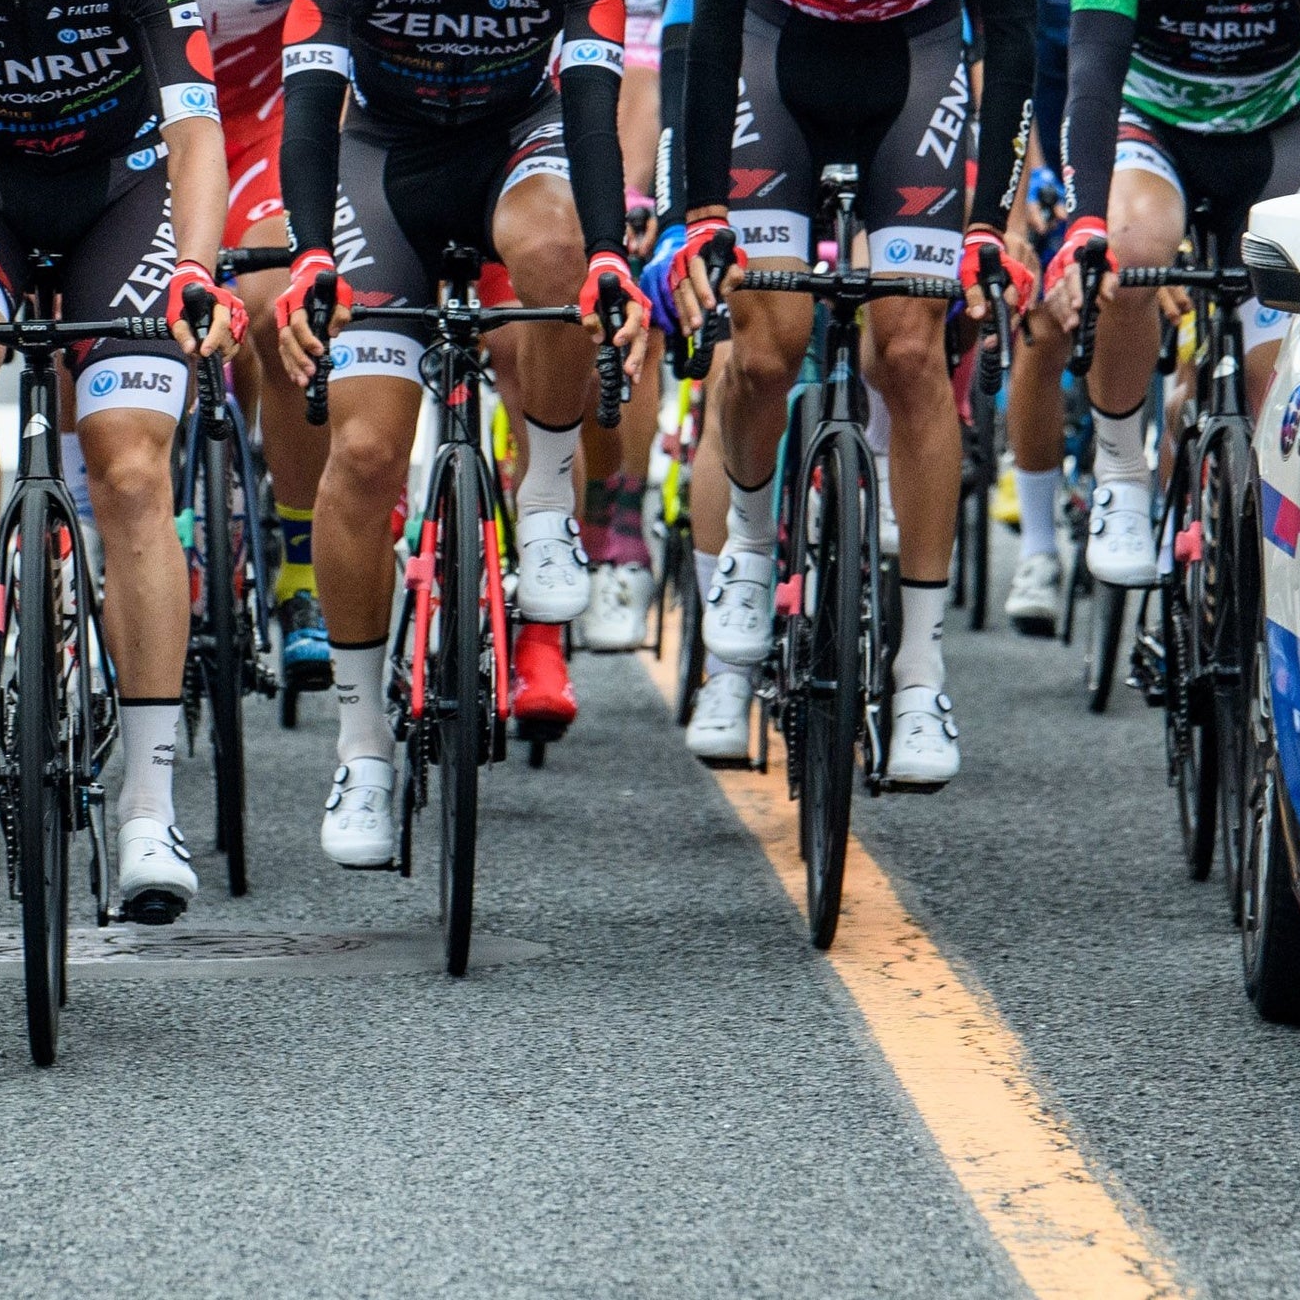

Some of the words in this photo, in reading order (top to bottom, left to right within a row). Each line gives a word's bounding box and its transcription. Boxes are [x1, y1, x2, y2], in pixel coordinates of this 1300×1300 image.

[67, 2, 110, 16] FACTOR
[79, 25, 113, 41] MJS
[367, 8, 551, 40] ZENRIN
[1158, 15, 1277, 41] ZENRIN
[415, 37, 541, 56] YOKOHAMA
[284, 50, 335, 68] MJS
[742, 225, 791, 244] MJS
[913, 245, 956, 266] MJS
[356, 346, 407, 366] MJS
[118, 371, 173, 394] MJS
